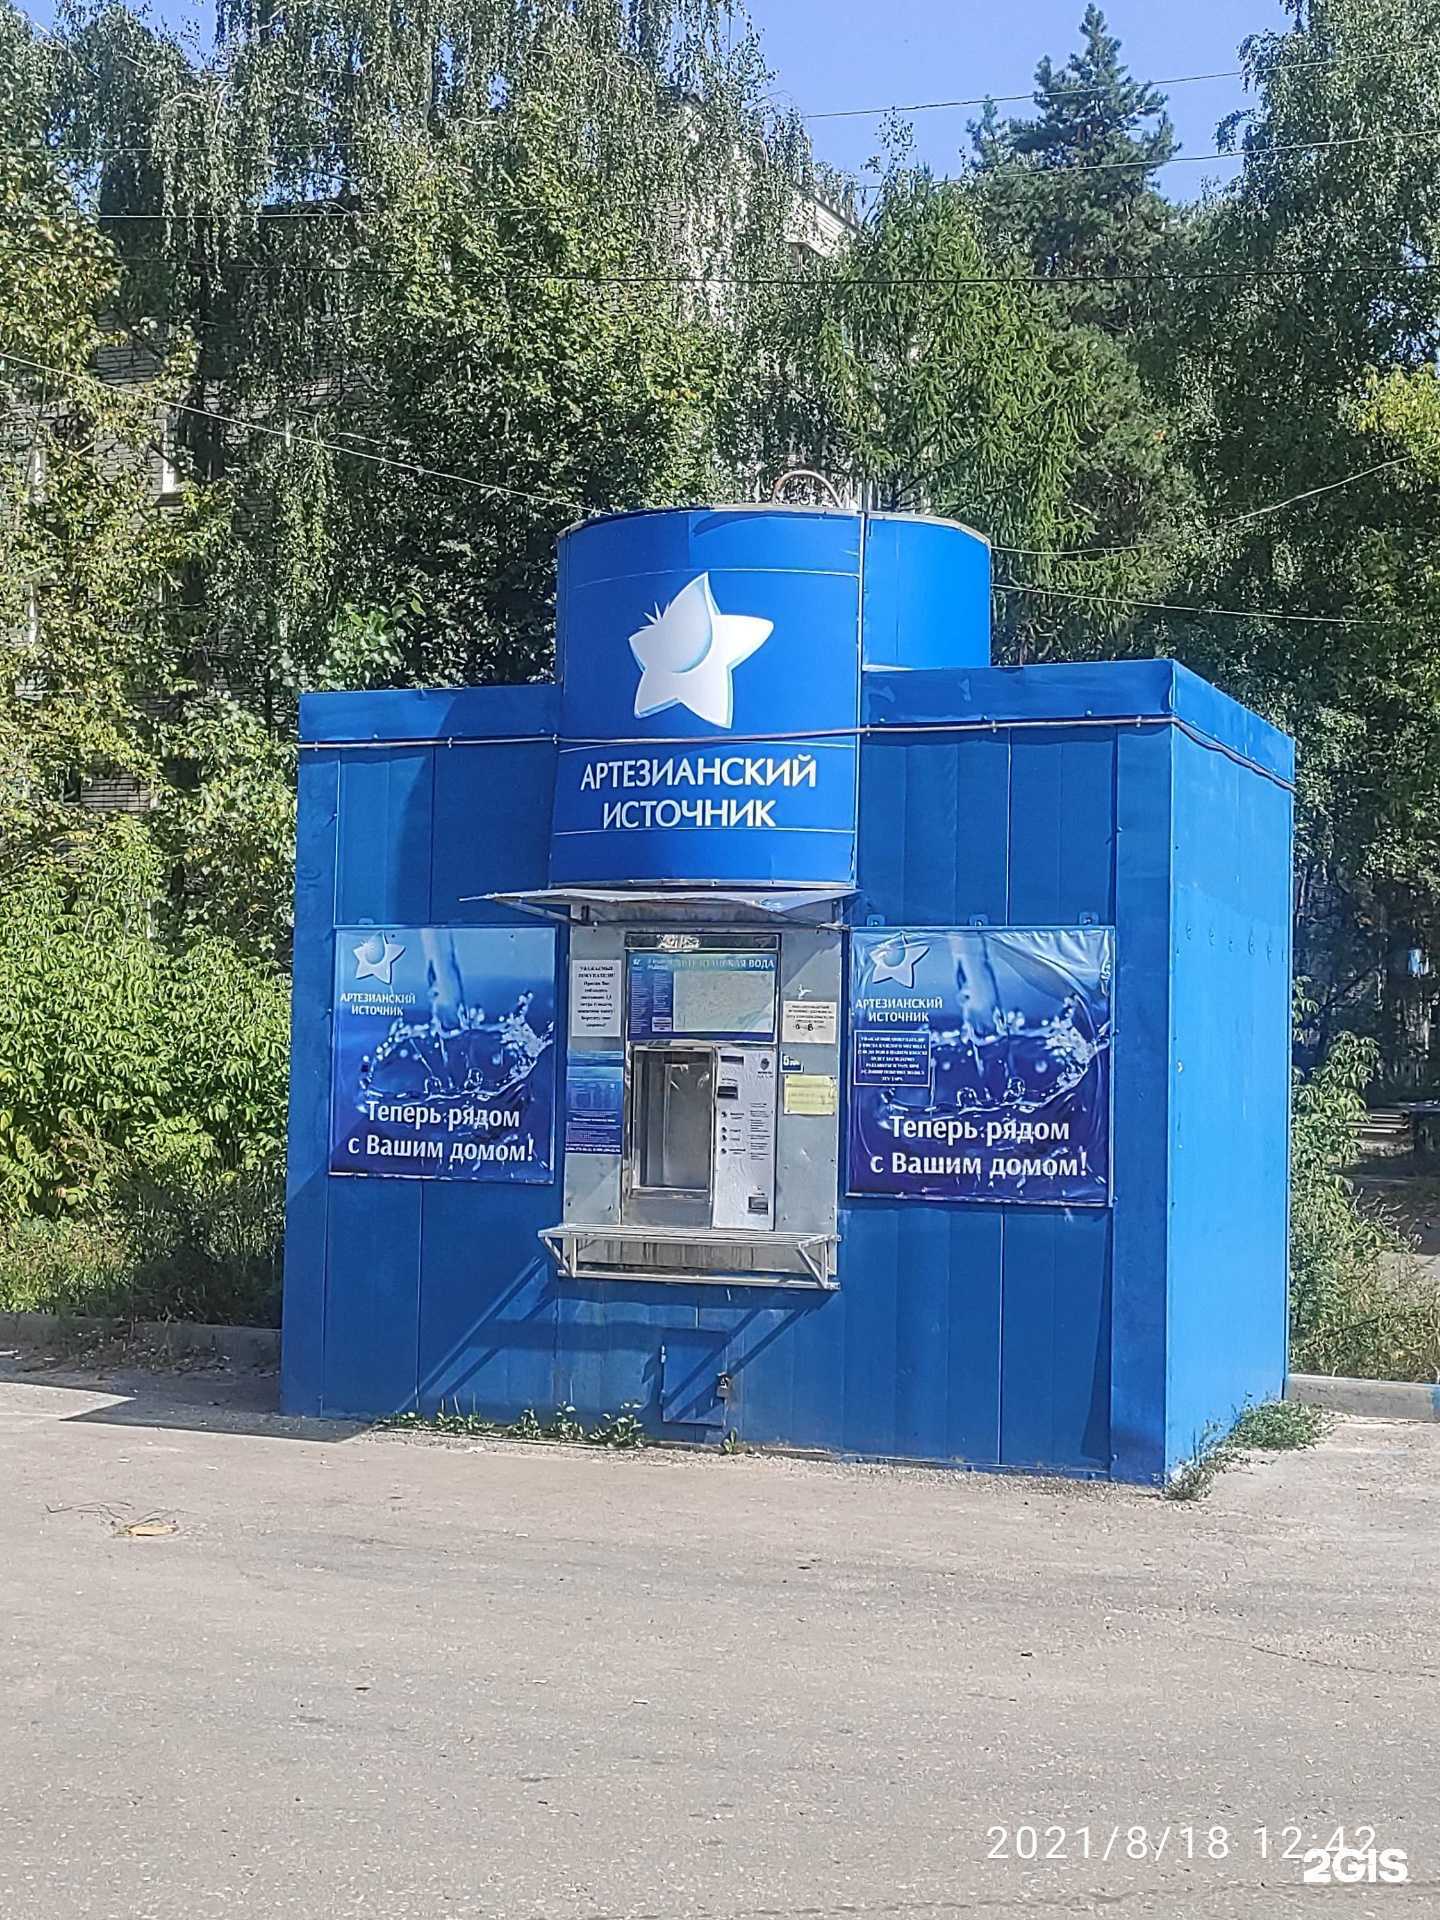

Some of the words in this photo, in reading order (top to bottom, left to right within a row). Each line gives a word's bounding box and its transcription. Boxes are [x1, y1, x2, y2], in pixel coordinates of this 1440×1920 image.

[580, 754, 817, 791] АРТЕЗИАНСКИЙ
[603, 799, 777, 830] ИСТОЧНИК
[748, 959, 775, 969] ВОДА
[340, 992, 416, 1005] АРТЕЗИАНСКИЙ
[351, 1005, 404, 1017] ИСТОЧНИК
[855, 997, 944, 1010] АРТЕЗИАНСКИЙ
[868, 1011, 930, 1023] ИСТОЧНИК
[366, 1100, 442, 1130] Теперь
[448, 1105, 520, 1131] рядом
[889, 1115, 978, 1146] Теперь
[986, 1120, 1070, 1146] рядом
[348, 1137, 361, 1154] с
[367, 1134, 443, 1158] Вашим
[449, 1138, 536, 1162] домом!
[870, 1155, 884, 1173] с
[892, 1152, 982, 1174] Вашим
[990, 1150, 1087, 1176] домом!
